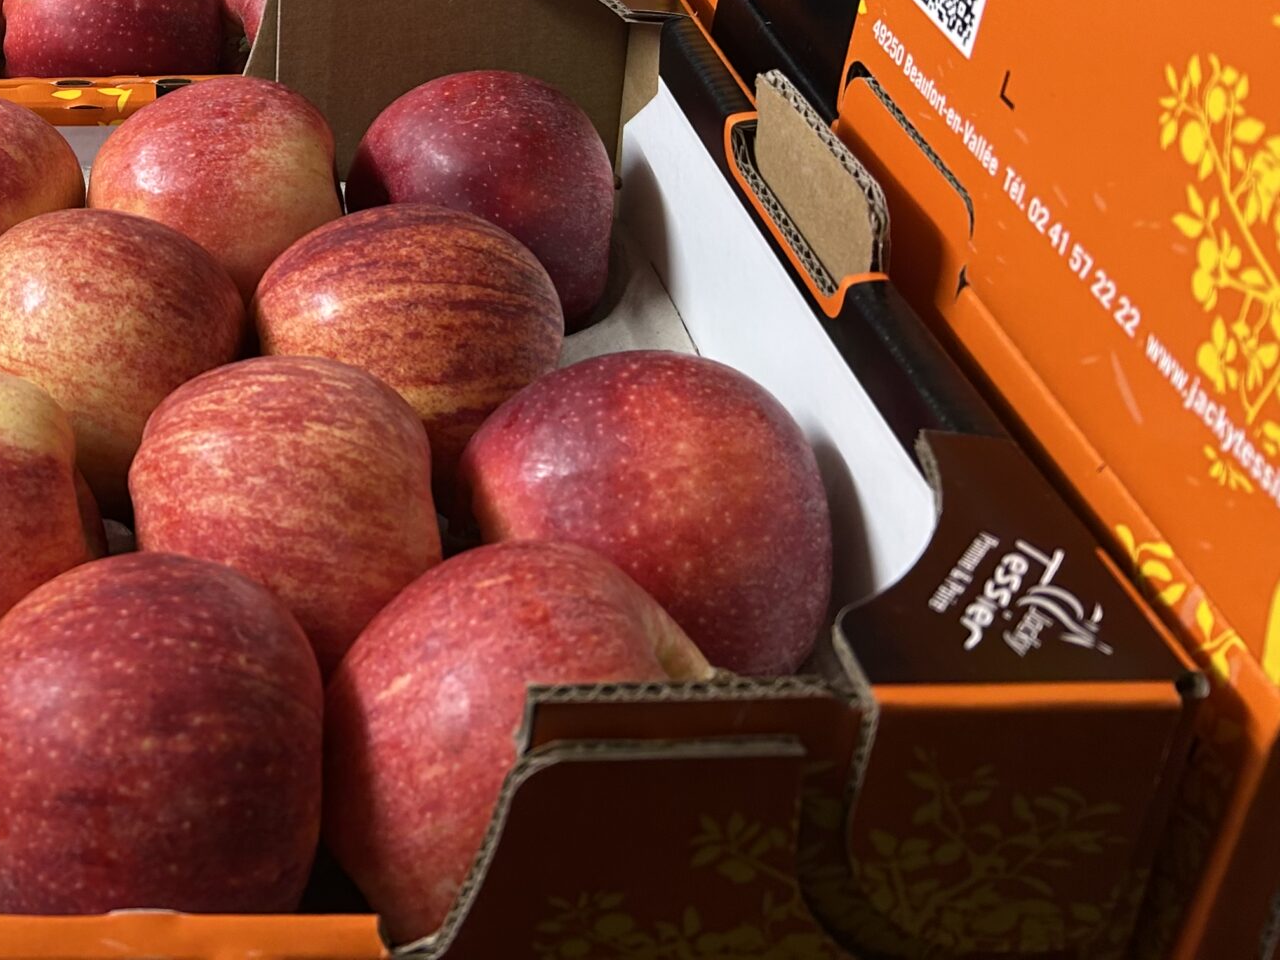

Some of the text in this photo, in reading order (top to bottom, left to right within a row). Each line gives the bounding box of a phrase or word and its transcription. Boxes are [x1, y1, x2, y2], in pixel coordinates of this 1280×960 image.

[872, 18, 905, 67] 49250
[903, 52, 999, 177] Beaufort-en-Vallée
[1003, 166, 1026, 212] Tél.
[1026, 197, 1051, 235] 02
[1047, 222, 1071, 257] 41
[1068, 243, 1094, 281] 57
[1090, 269, 1117, 310] 22
[1113, 294, 1141, 338] 22
[960, 539, 1066, 651] Tessier
